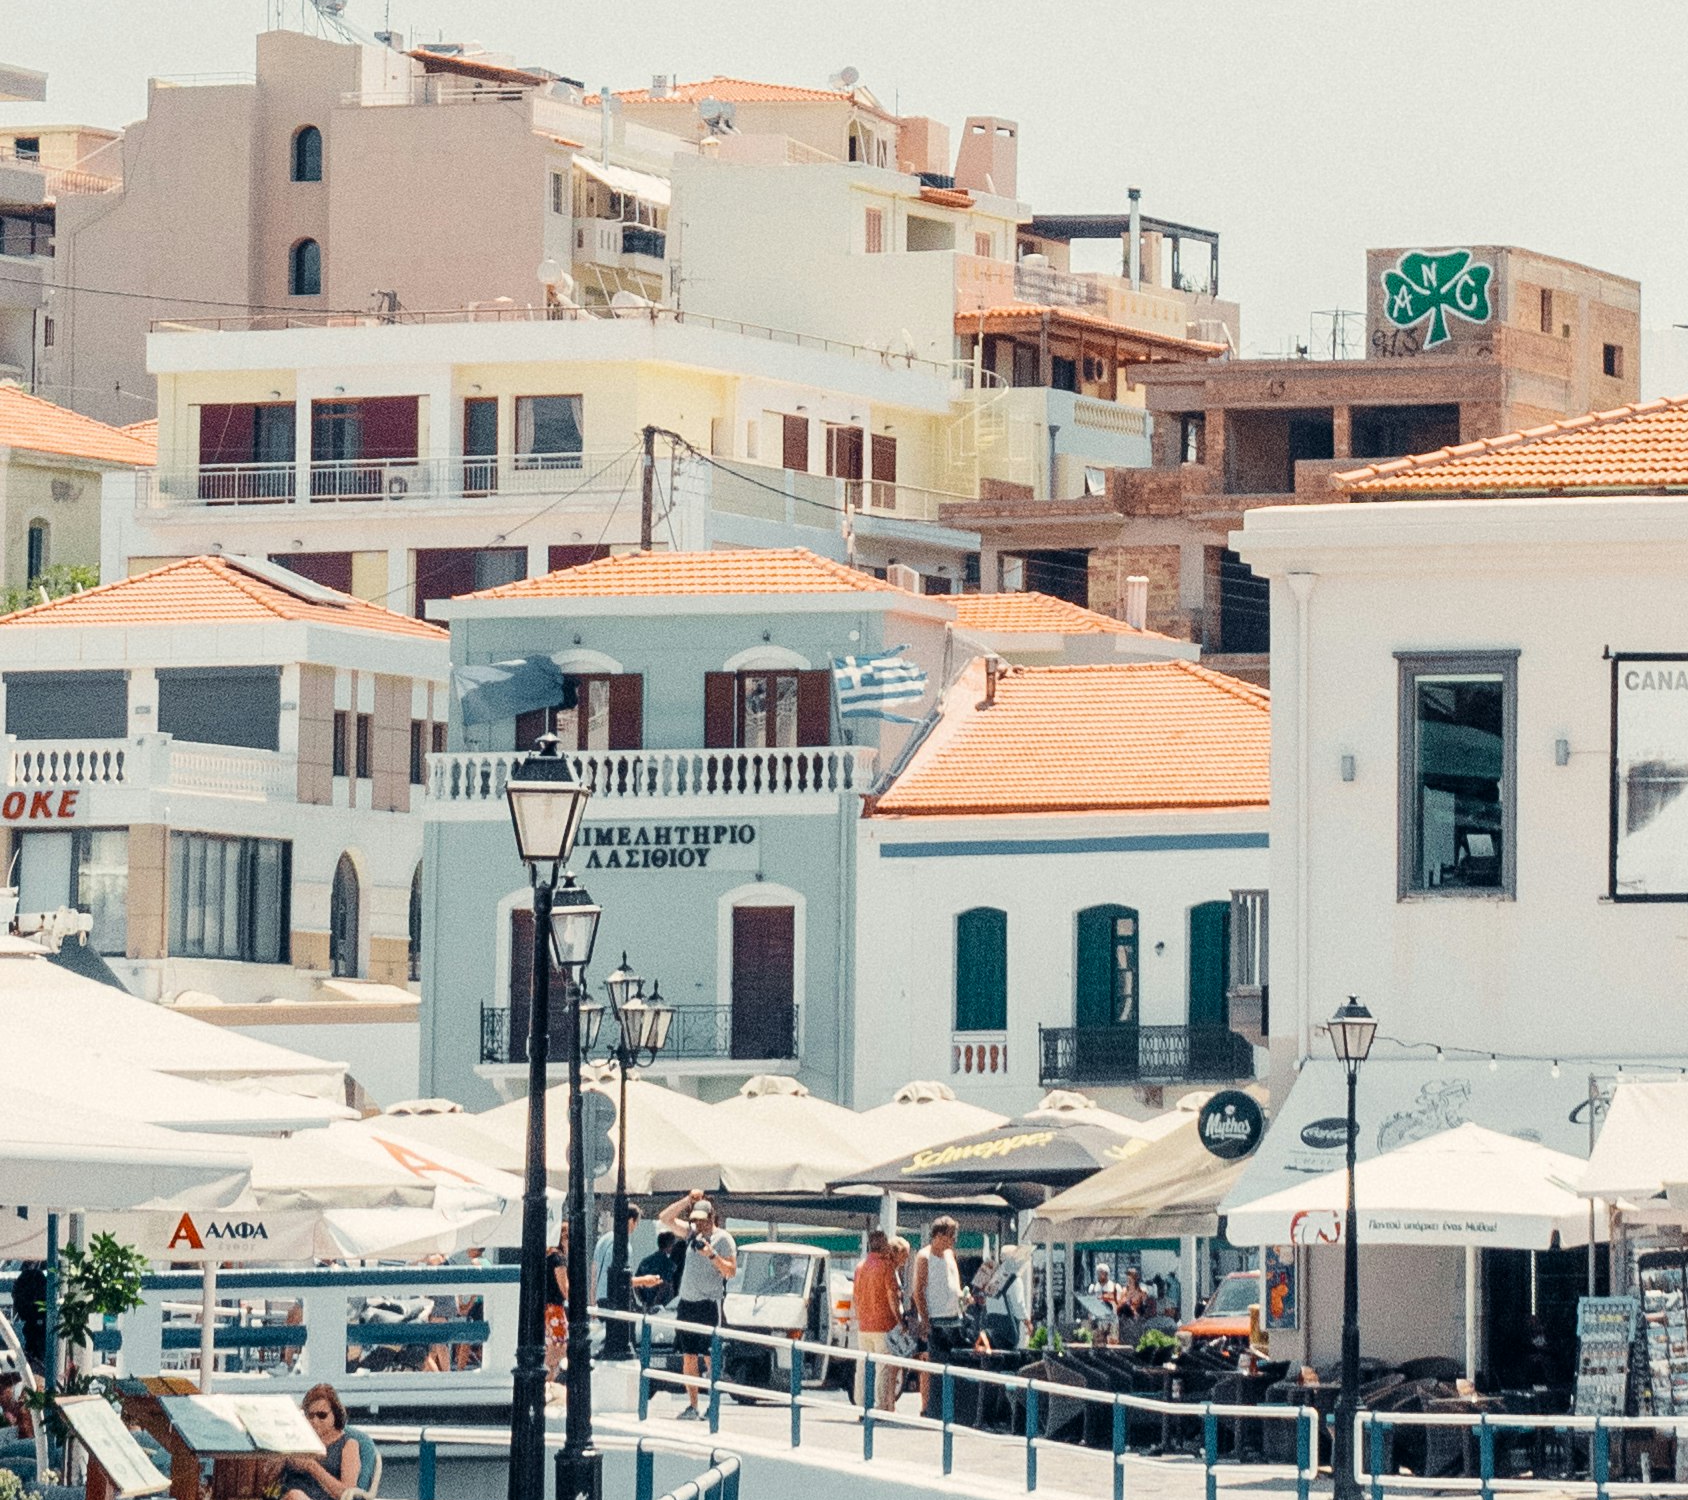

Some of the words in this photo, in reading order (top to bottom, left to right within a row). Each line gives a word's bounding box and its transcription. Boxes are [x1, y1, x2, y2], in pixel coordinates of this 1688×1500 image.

[2, 790, 80, 820] OKE
[586, 847, 711, 869] ΛΑΣΙΘΙΟΥ
[1205, 1112, 1251, 1139] Mythos
[205, 1221, 268, 1239] ΑΛΦΑ
